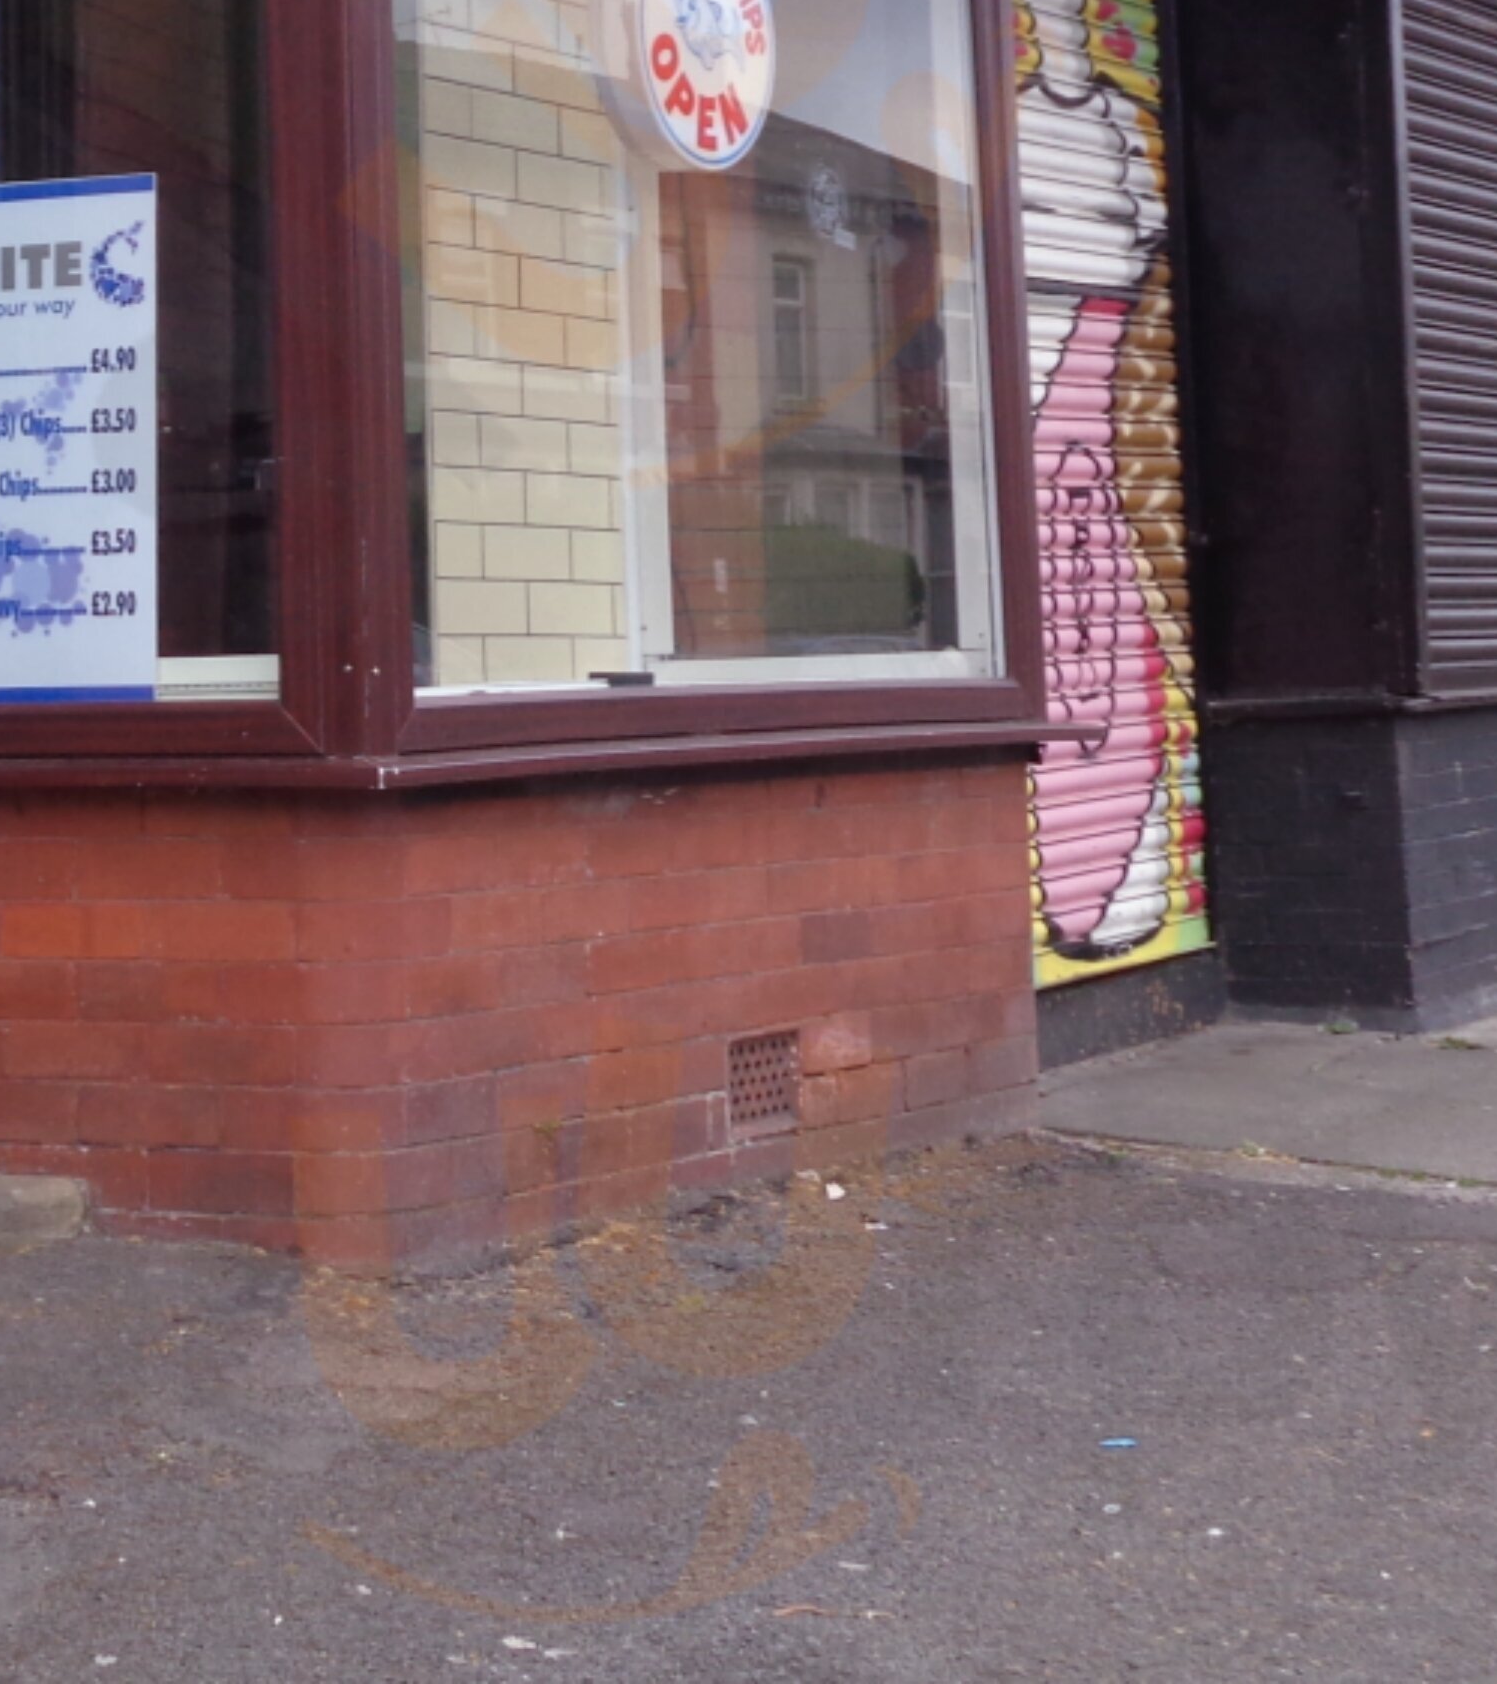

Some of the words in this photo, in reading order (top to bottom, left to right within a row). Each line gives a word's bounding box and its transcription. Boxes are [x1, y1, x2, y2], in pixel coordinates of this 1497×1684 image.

[651, 32, 750, 152] OPEN
[34, 298, 77, 319] way
[90, 347, 137, 374] £4.90
[90, 408, 137, 435] £3.50
[90, 468, 137, 495] £3.00
[91, 528, 137, 556] £3.50
[90, 590, 137, 617] £2.90
